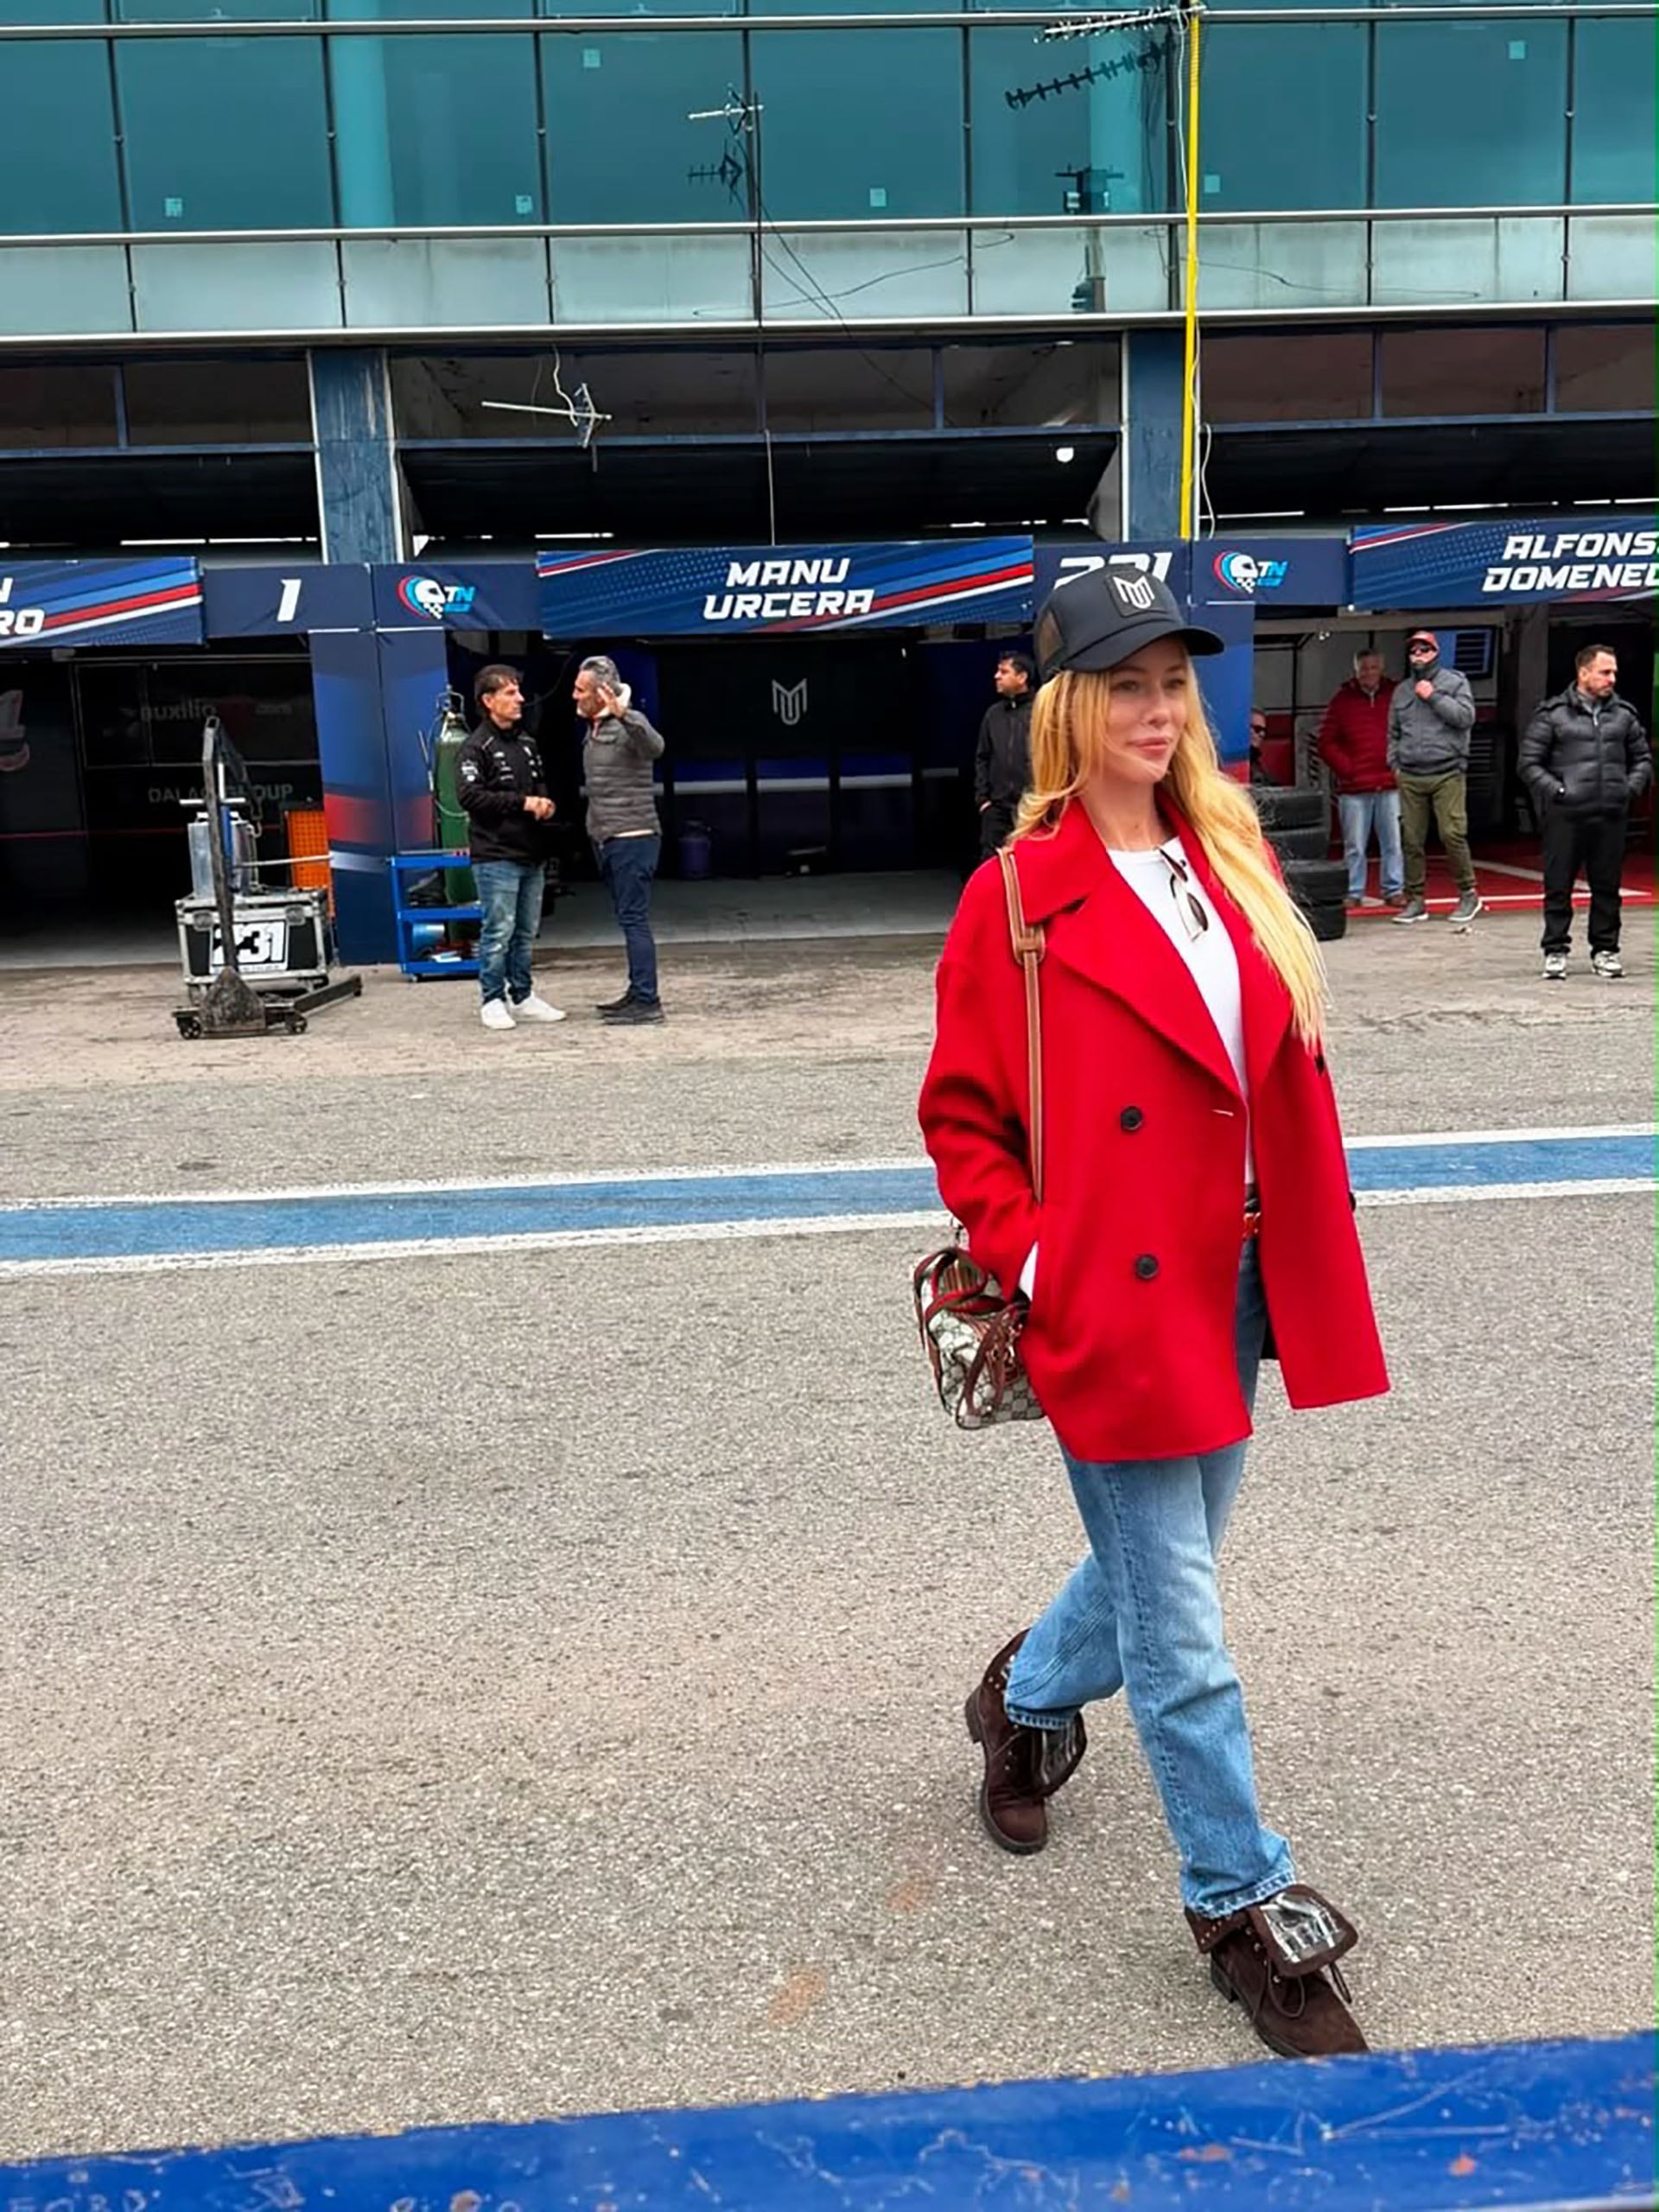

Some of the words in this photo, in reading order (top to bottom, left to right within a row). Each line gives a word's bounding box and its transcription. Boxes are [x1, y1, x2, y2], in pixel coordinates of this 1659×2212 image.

[1502, 531, 1659, 560] ALFONS
[726, 558, 850, 588] MANU
[277, 579, 302, 621] 1
[702, 589, 874, 620] URCERA
